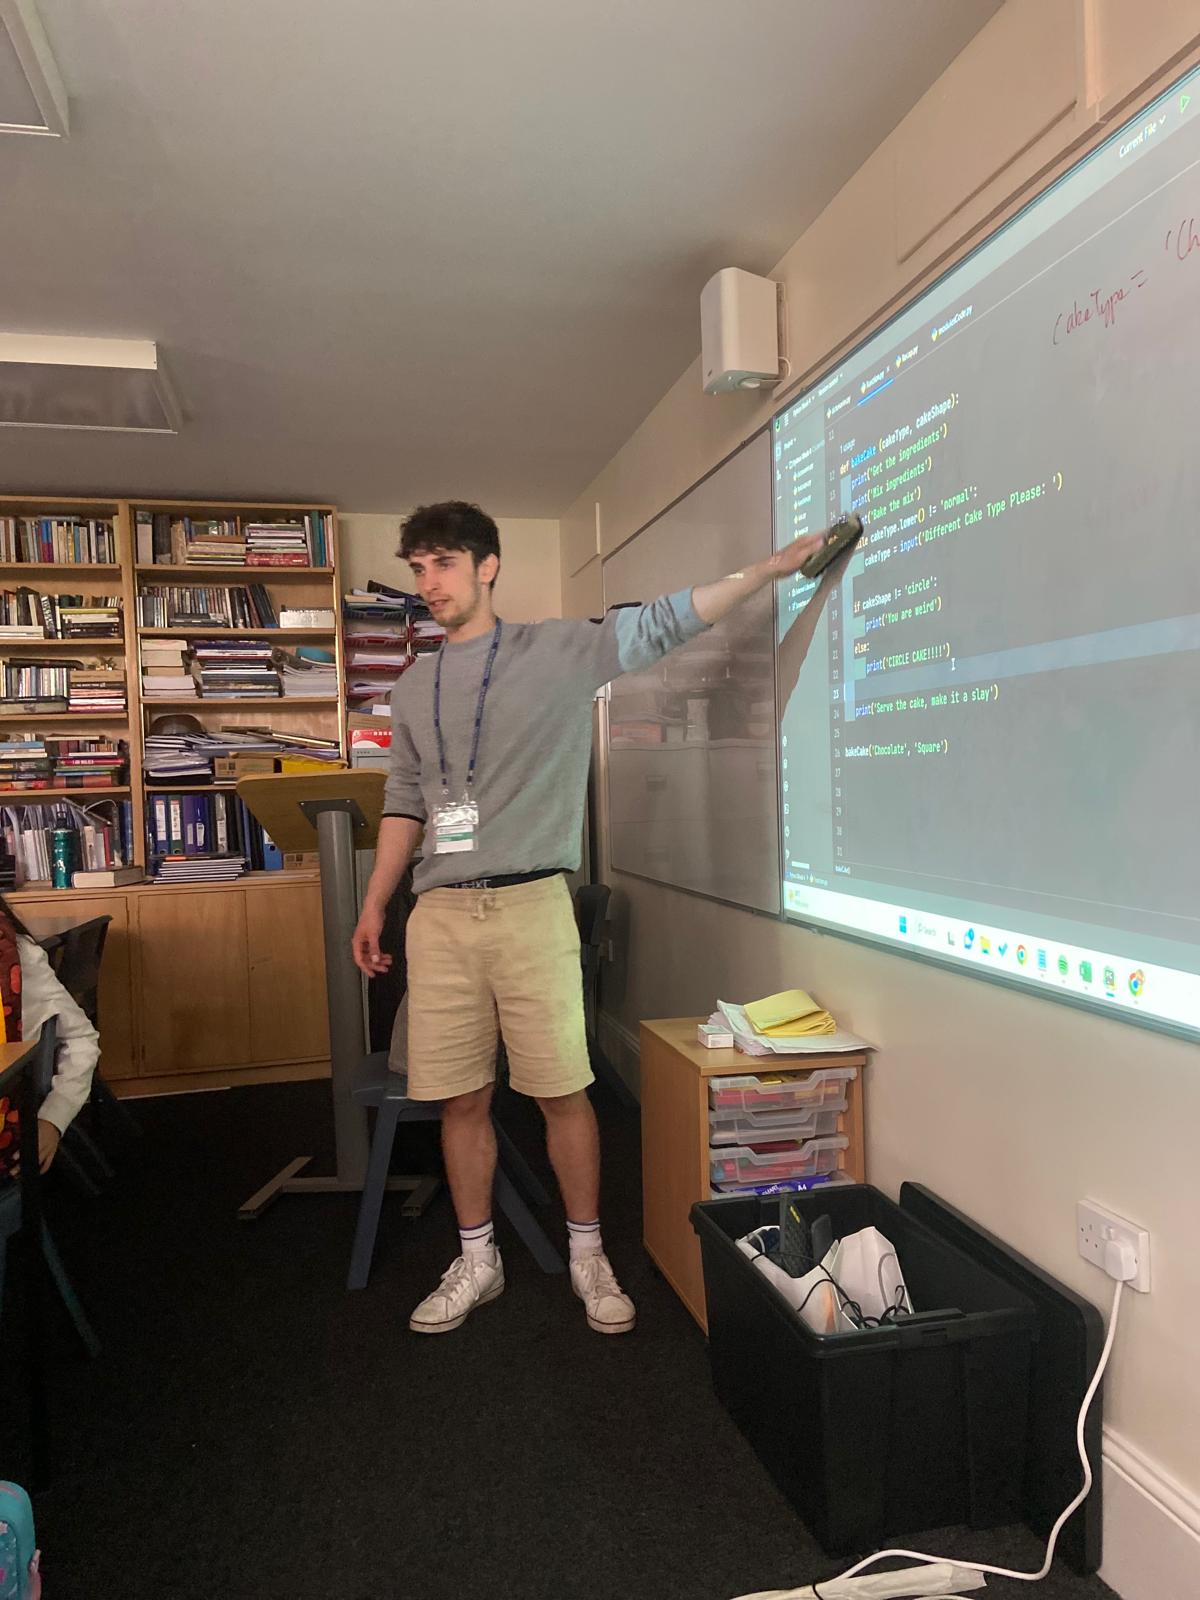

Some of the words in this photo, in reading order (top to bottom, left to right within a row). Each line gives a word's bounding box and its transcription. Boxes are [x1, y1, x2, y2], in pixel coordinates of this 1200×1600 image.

[885, 455, 896, 469] the
[899, 422, 948, 462] ingredients')
[886, 455, 932, 492] ingredients')
[889, 499, 900, 512] the
[864, 547, 891, 567] cakeType
[964, 509, 983, 526] Cake
[986, 499, 1006, 518] Type
[1009, 482, 1046, 508] Please:
[854, 600, 861, 613] if
[862, 592, 892, 610] cakeShape
[901, 608, 913, 621] are
[915, 595, 942, 617] weird')
[854, 642, 870, 655] else:
[896, 699, 907, 711] the
[909, 697, 928, 710] cake,
[931, 693, 948, 706] make
[950, 690, 959, 704] it
[962, 694, 968, 702] a
[971, 683, 999, 702] slay')
[914, 738, 948, 756] 'Square')
[797, 1183, 807, 1192] A4
